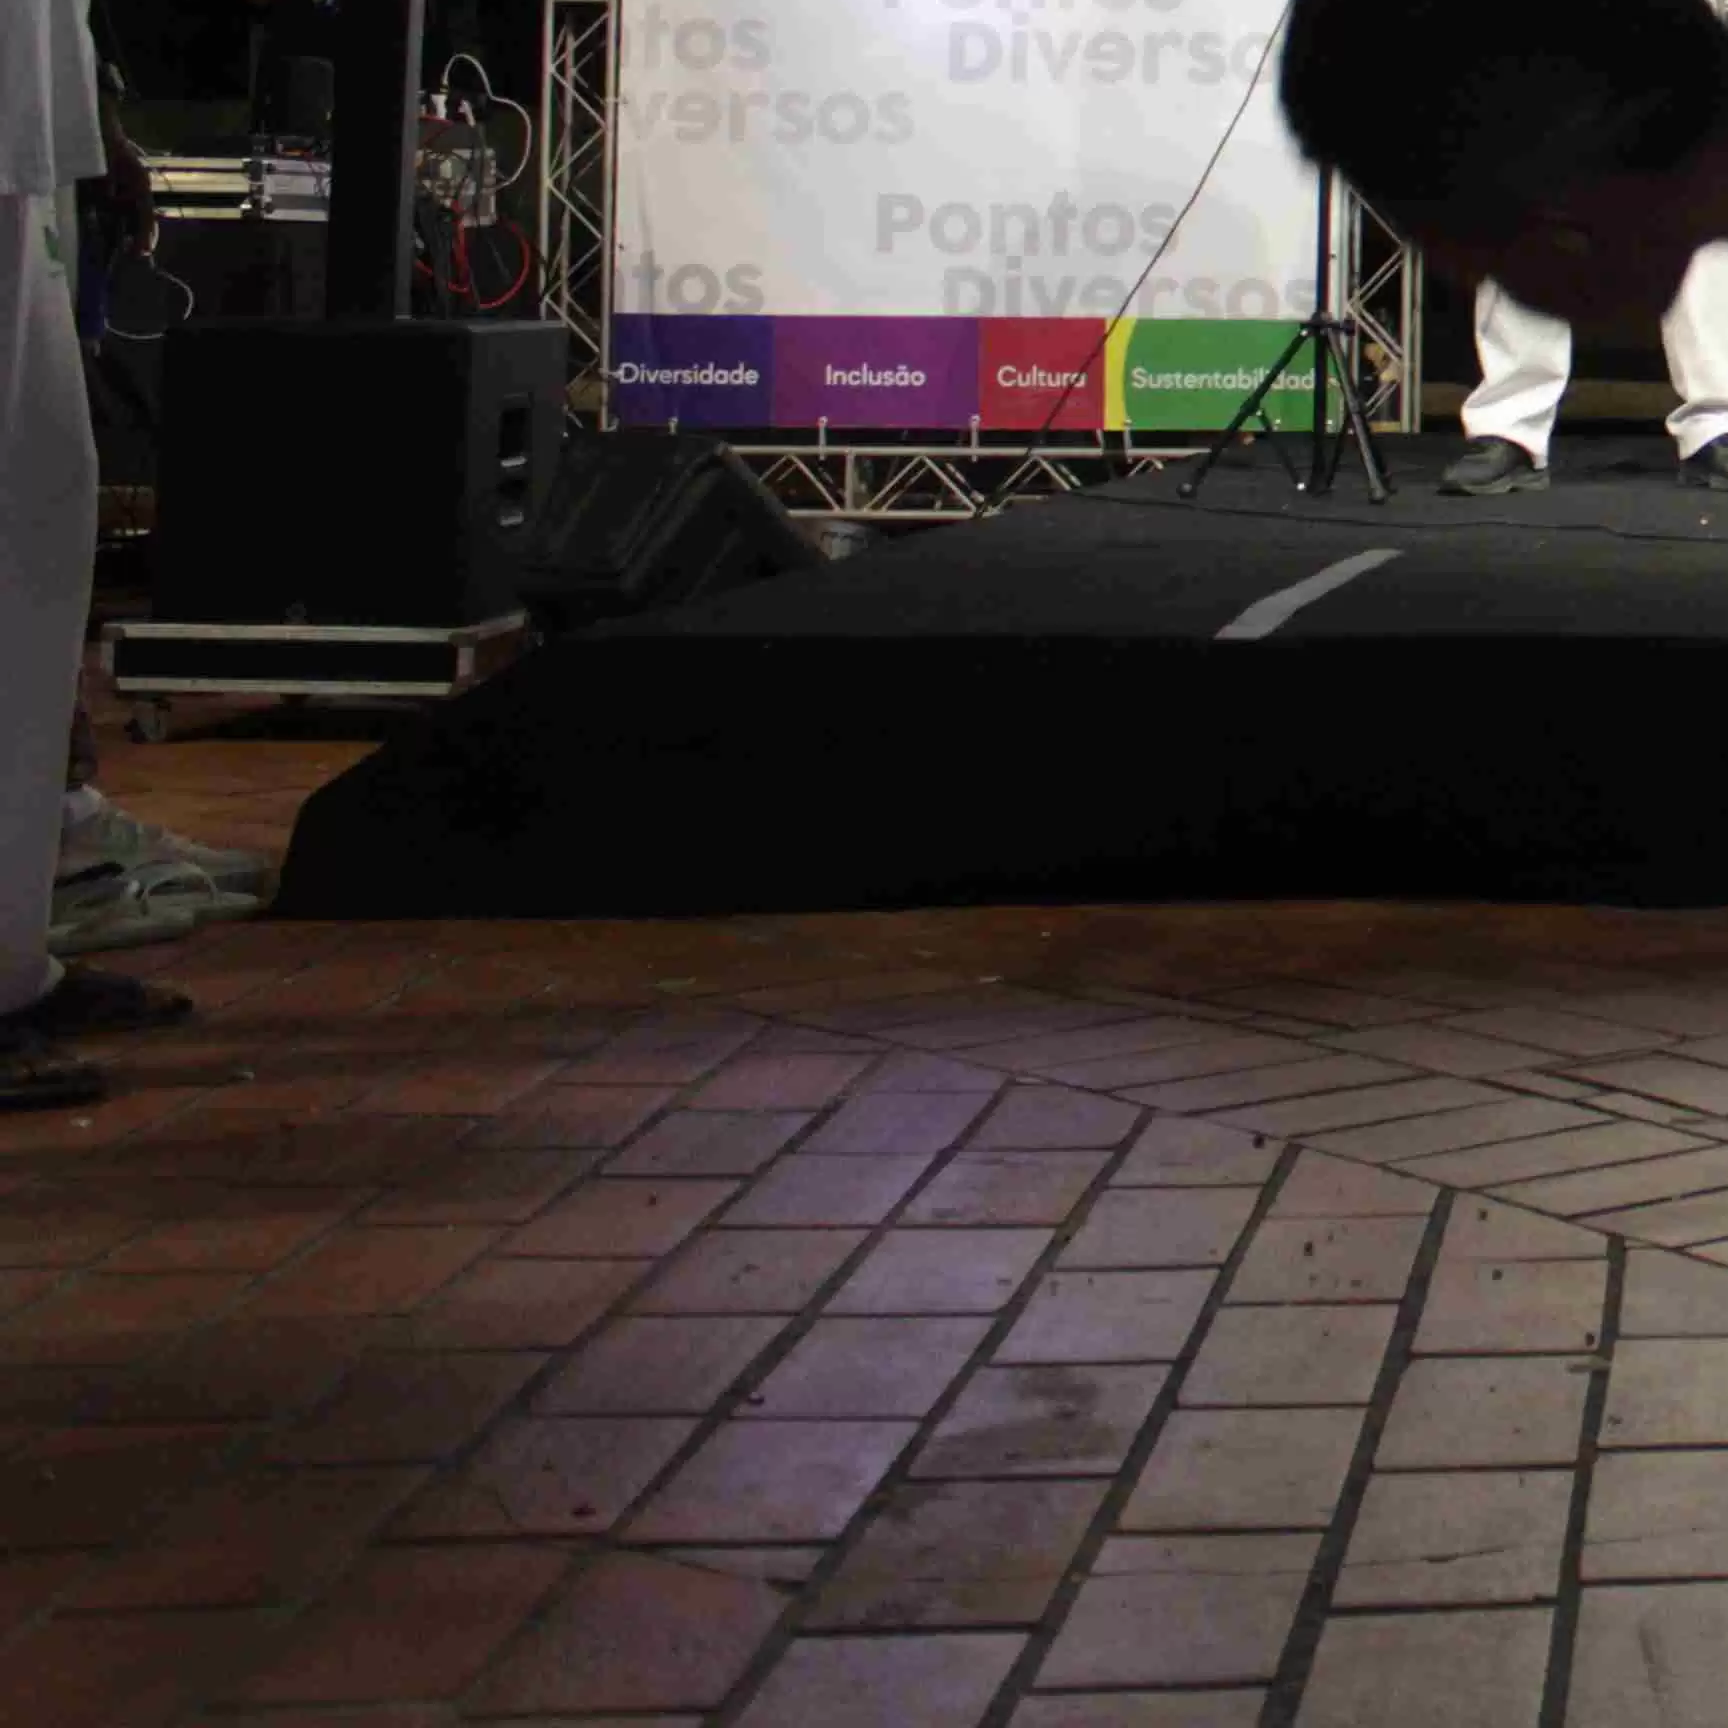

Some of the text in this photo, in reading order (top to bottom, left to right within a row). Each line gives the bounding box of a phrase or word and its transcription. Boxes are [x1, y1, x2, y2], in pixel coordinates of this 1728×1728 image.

[623, 2, 771, 72] tos
[875, 189, 1181, 256] Pontos
[615, 249, 765, 313] tos
[618, 361, 759, 387] Diversidade
[824, 360, 926, 388] Inclusão
[997, 364, 1087, 389] Cultura
[1131, 365, 1316, 390] Sustentabildad
